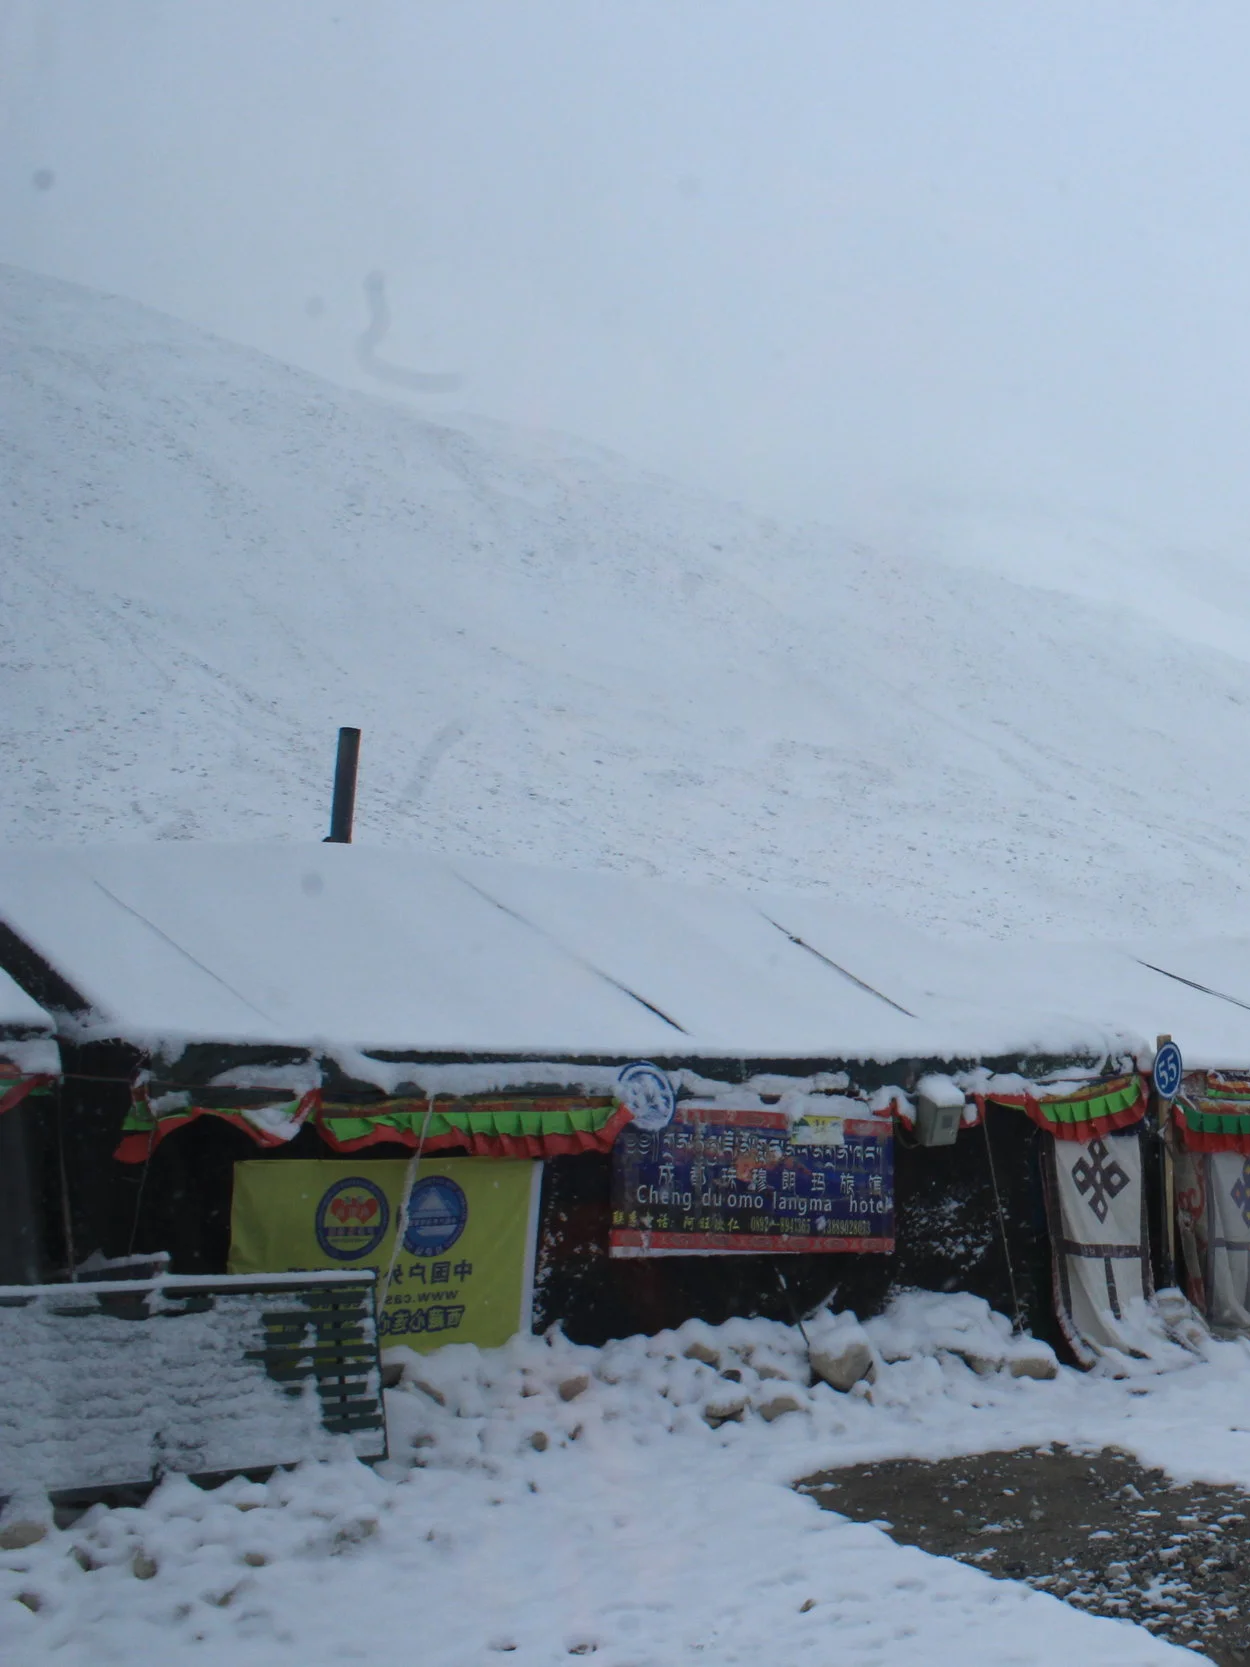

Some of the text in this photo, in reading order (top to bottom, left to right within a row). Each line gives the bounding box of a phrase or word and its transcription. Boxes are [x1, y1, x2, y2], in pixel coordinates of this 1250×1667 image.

[1158, 1052, 1177, 1090] 55
[636, 1184, 692, 1212] Cheng
[772, 1192, 832, 1216] langma
